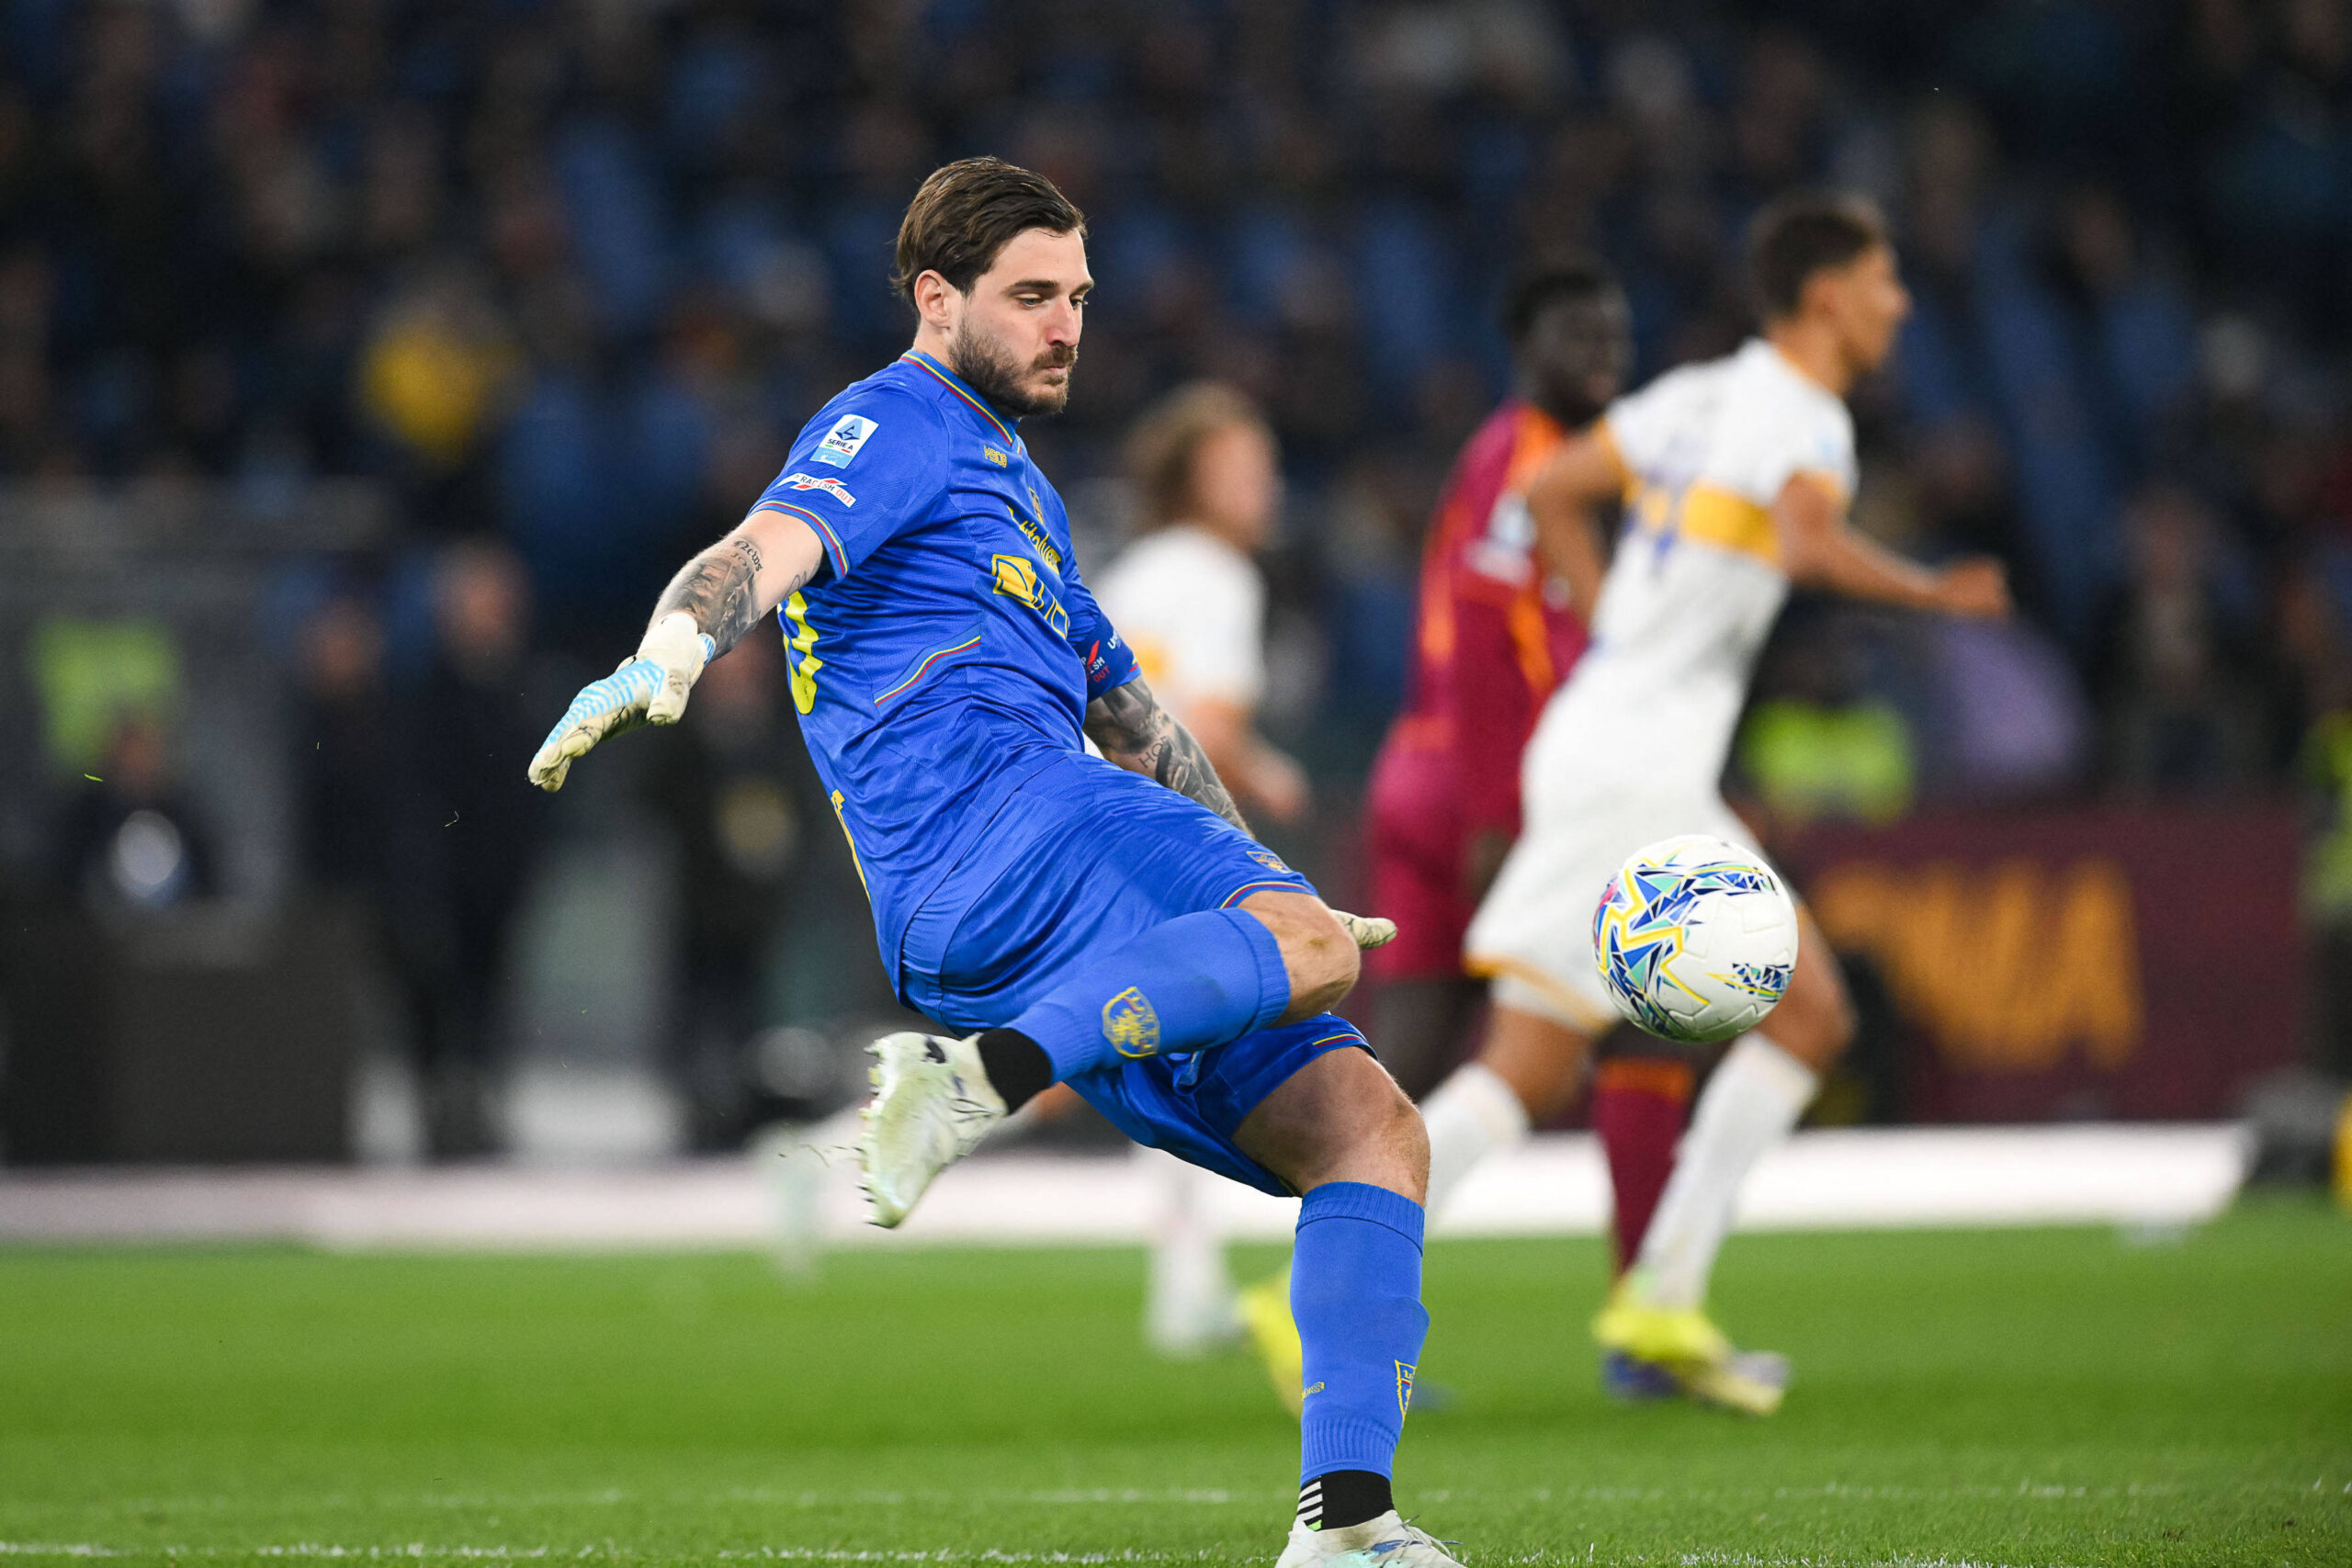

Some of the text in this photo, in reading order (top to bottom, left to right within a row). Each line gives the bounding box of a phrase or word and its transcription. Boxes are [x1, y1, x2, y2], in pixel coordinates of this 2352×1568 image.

[828, 438, 848, 449] SERIE
[799, 476, 853, 504] RACISM OUT
[1092, 665, 1111, 682] OUT
